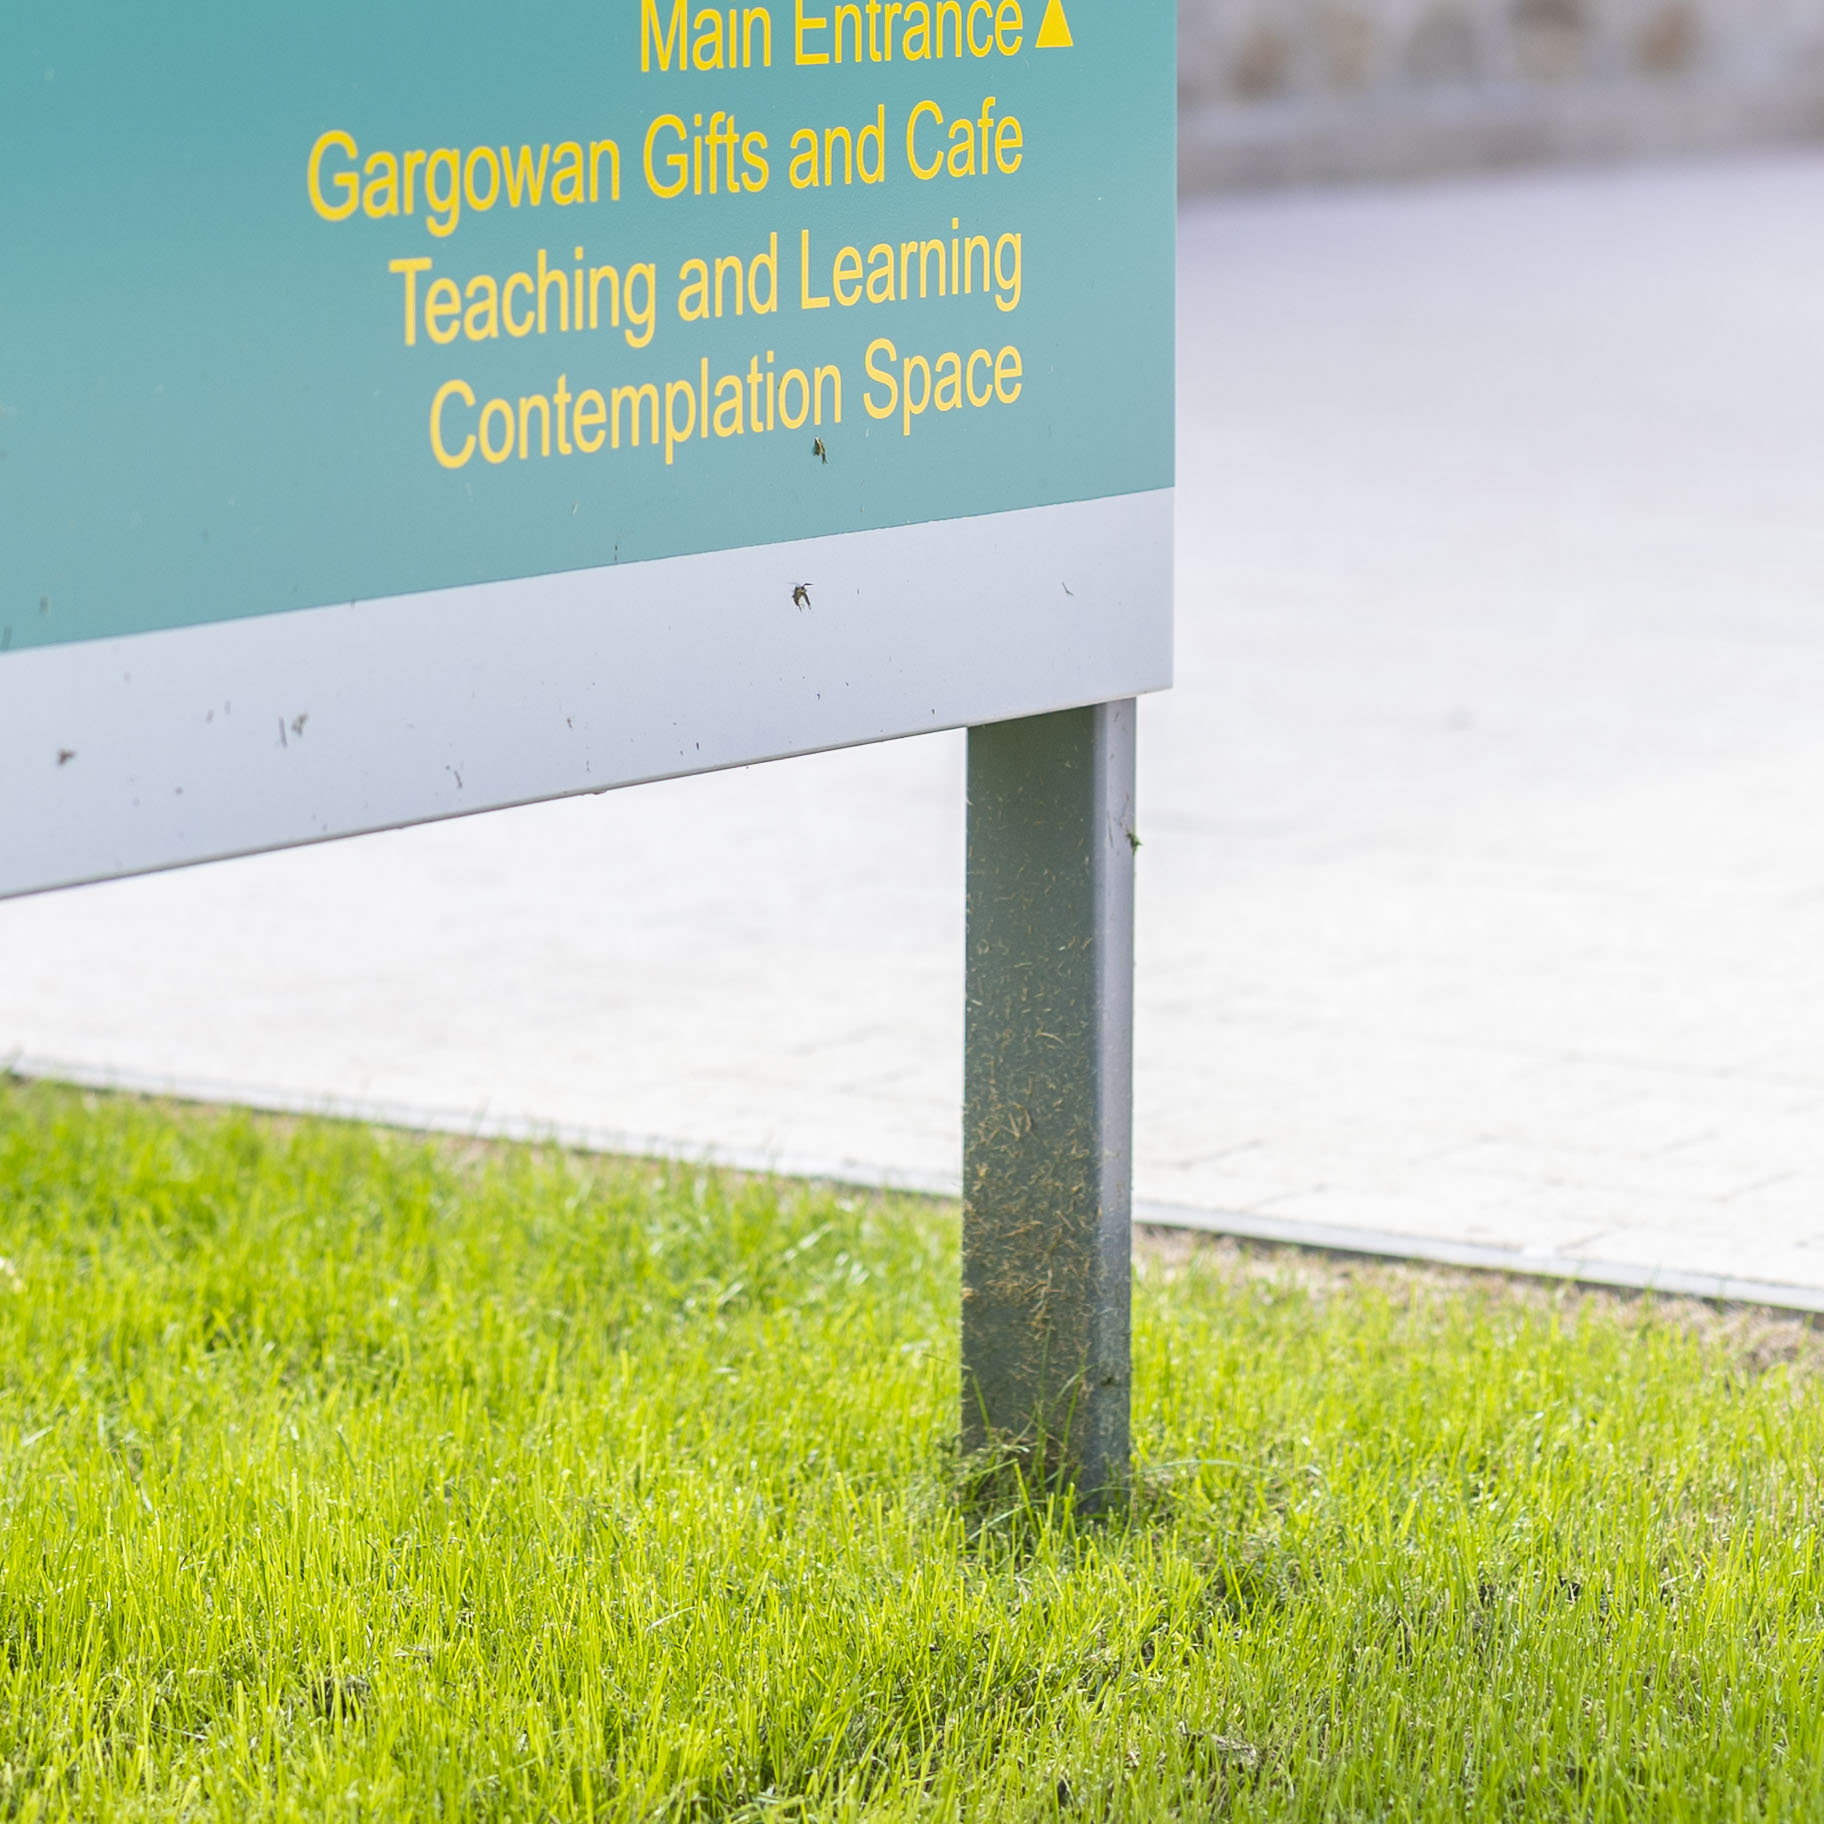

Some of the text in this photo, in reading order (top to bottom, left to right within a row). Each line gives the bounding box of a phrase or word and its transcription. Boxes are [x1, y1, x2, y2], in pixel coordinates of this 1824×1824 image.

[306, 94, 1024, 239] Gargowan Gifts and Cafe
[387, 216, 1023, 350] Teaching and Learning
[429, 336, 1024, 470] Contemplation Space
